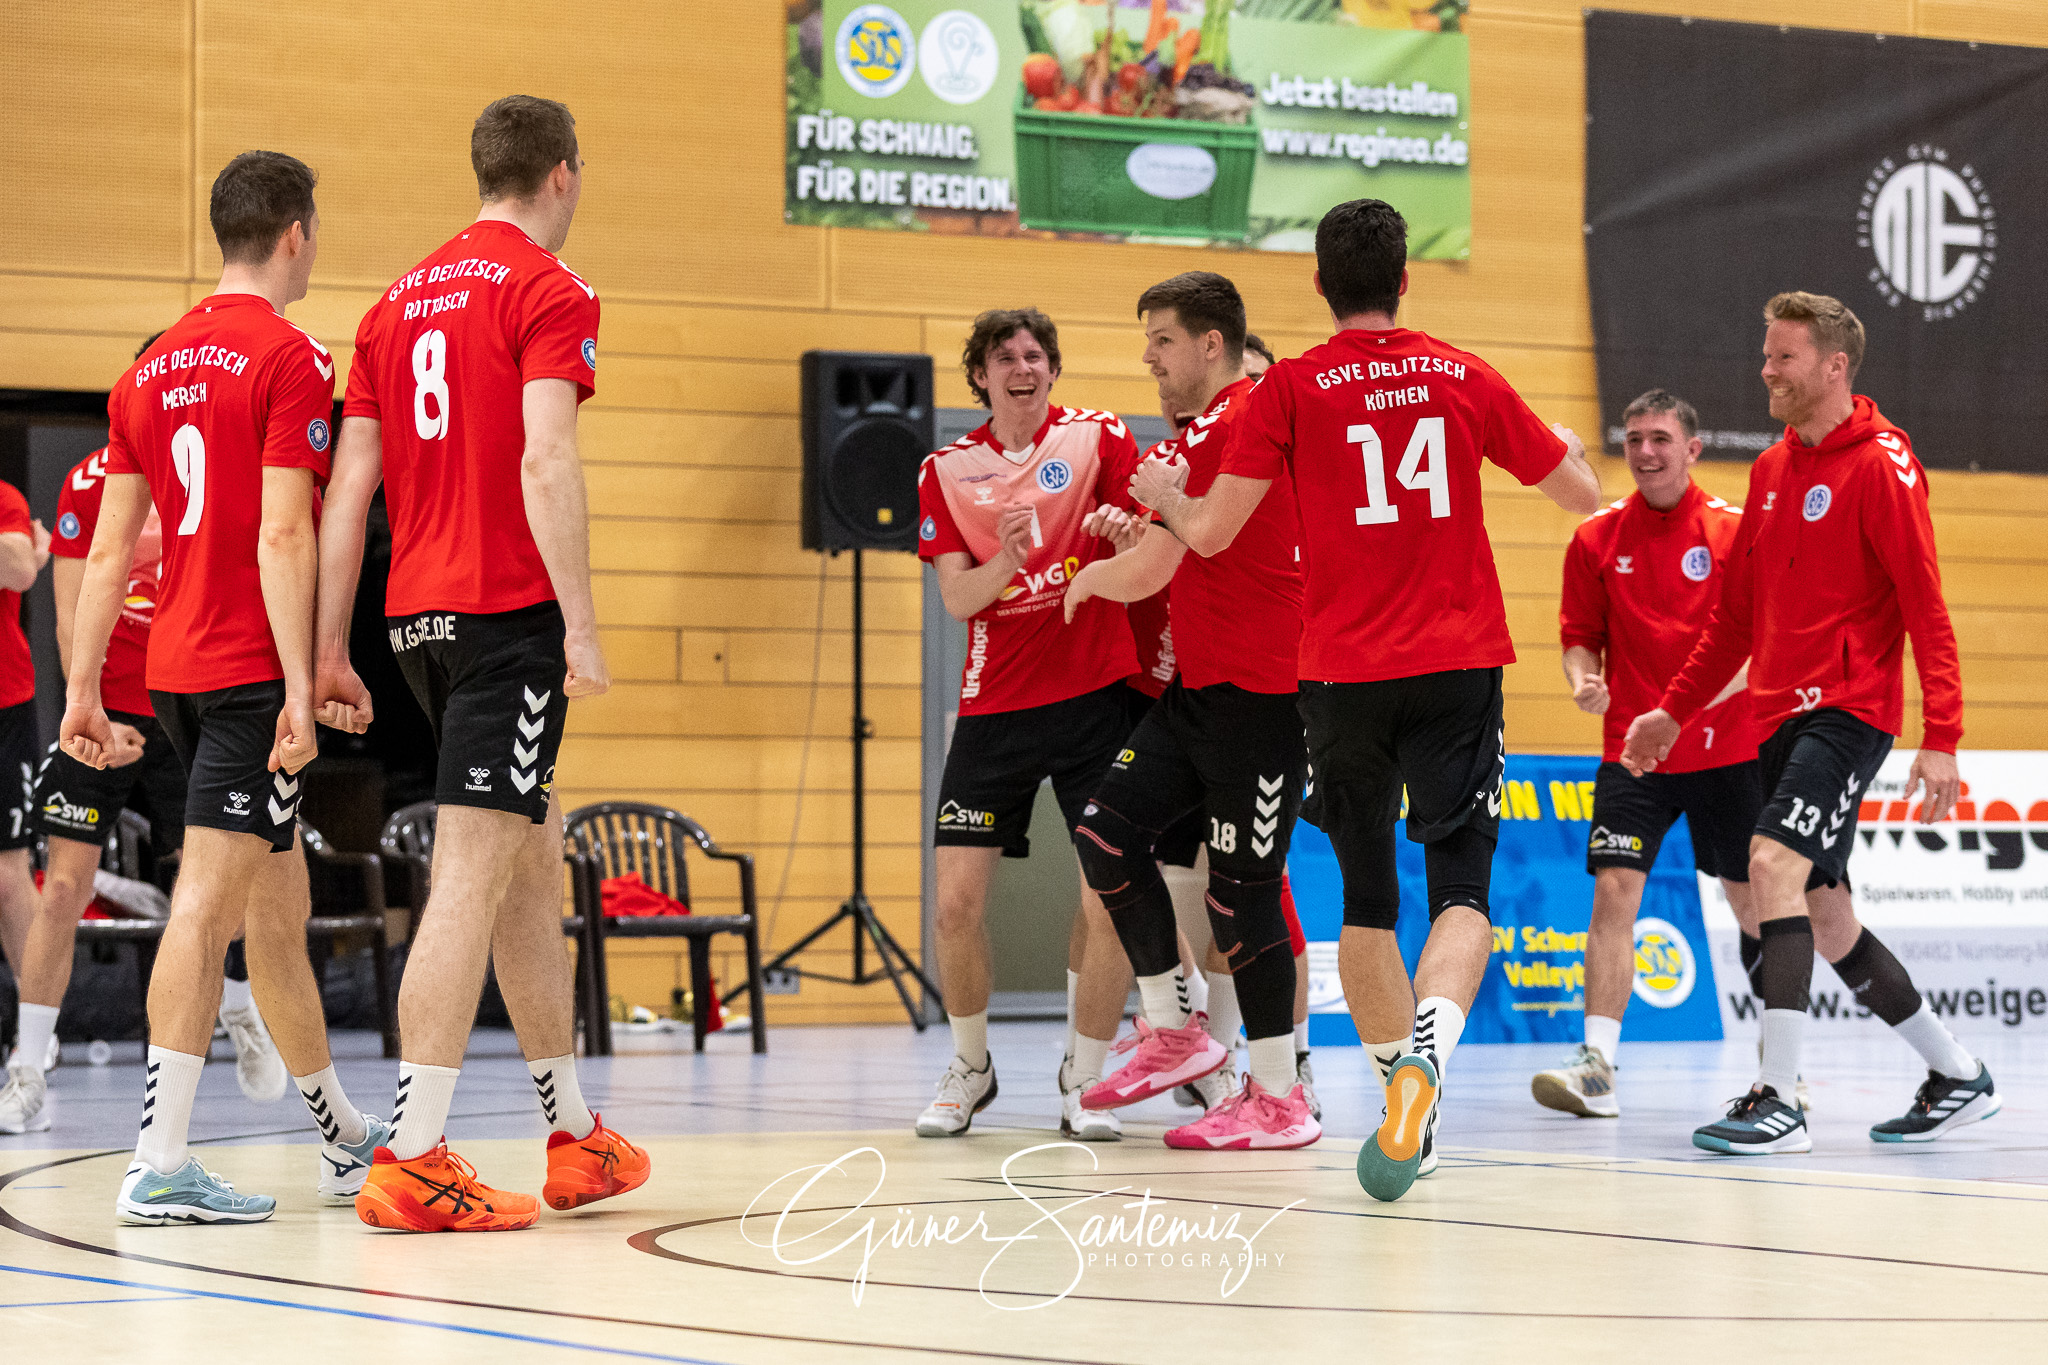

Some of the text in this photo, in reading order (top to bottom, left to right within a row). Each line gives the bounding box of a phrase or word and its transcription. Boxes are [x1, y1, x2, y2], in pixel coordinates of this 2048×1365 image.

[1262, 73, 1458, 117] Jetzt bestellen
[797, 108, 979, 160] FÜR SCHWAIG.
[797, 159, 1018, 212] FÜR DIE REGION.
[388, 258, 511, 302] GSVE DELITZSCH
[135, 345, 250, 389] GSVE DELITZSCH
[411, 328, 450, 441] 8
[1315, 356, 1466, 390] GSVE DELITZSCH
[161, 382, 207, 411] MERSCH
[1364, 385, 1430, 411] KÖTHEN
[170, 422, 206, 536] 9
[1346, 416, 1451, 526] 14
[1024, 556, 1080, 594] WGD
[465, 782, 492, 792] hummel
[61, 803, 99, 824] SWD
[223, 805, 251, 816] hummel
[956, 808, 995, 826] SWD
[1780, 796, 1821, 837] 13
[1210, 816, 1237, 854] 18
[1607, 833, 1643, 851] SWD
[1961, 884, 2014, 903] Hobby
[1503, 961, 1584, 993] Volleyb
